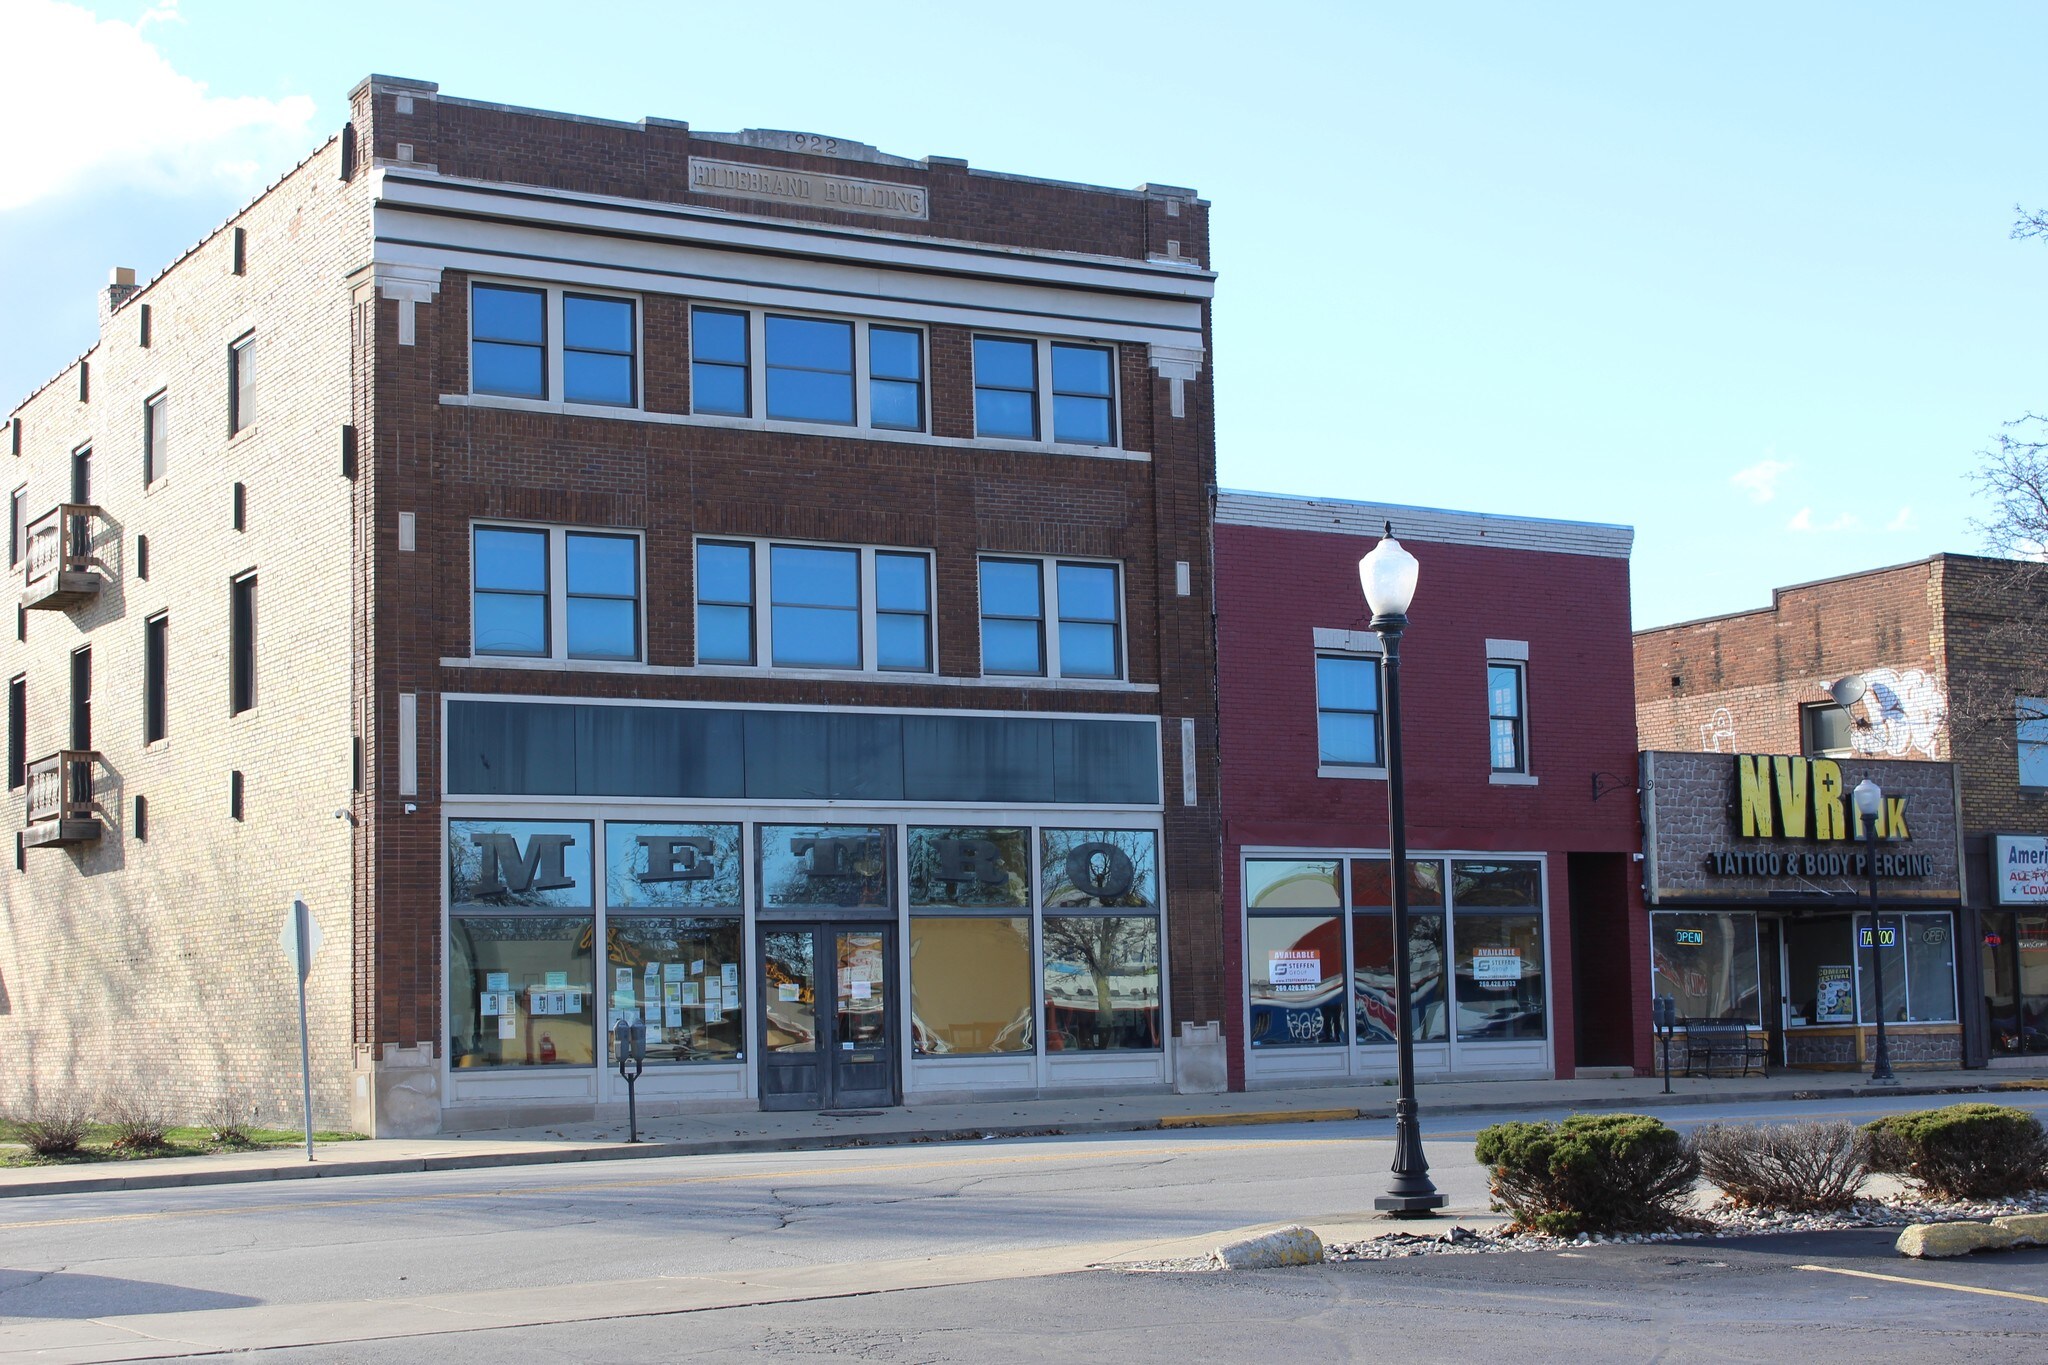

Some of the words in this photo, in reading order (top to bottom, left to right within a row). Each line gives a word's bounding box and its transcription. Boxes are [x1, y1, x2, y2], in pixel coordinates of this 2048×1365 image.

[785, 134, 837, 155] 1922
[693, 165, 810, 199] HILDEBRAND
[824, 181, 922, 214] BUILDING
[1713, 852, 1780, 876] TATTOO
[1787, 853, 1799, 876] &
[1805, 854, 1849, 876] BODY
[1856, 854, 1934, 876] PERCING
[2009, 872, 2030, 881] ALL
[1677, 931, 1700, 942] OPEN
[1863, 930, 1893, 945] TAOO
[1923, 930, 1947, 942] OPEN
[1274, 951, 1315, 959] AVAILABLE
[1478, 948, 1515, 956] AVAILABLE
[1818, 968, 1849, 976] COMEDY
